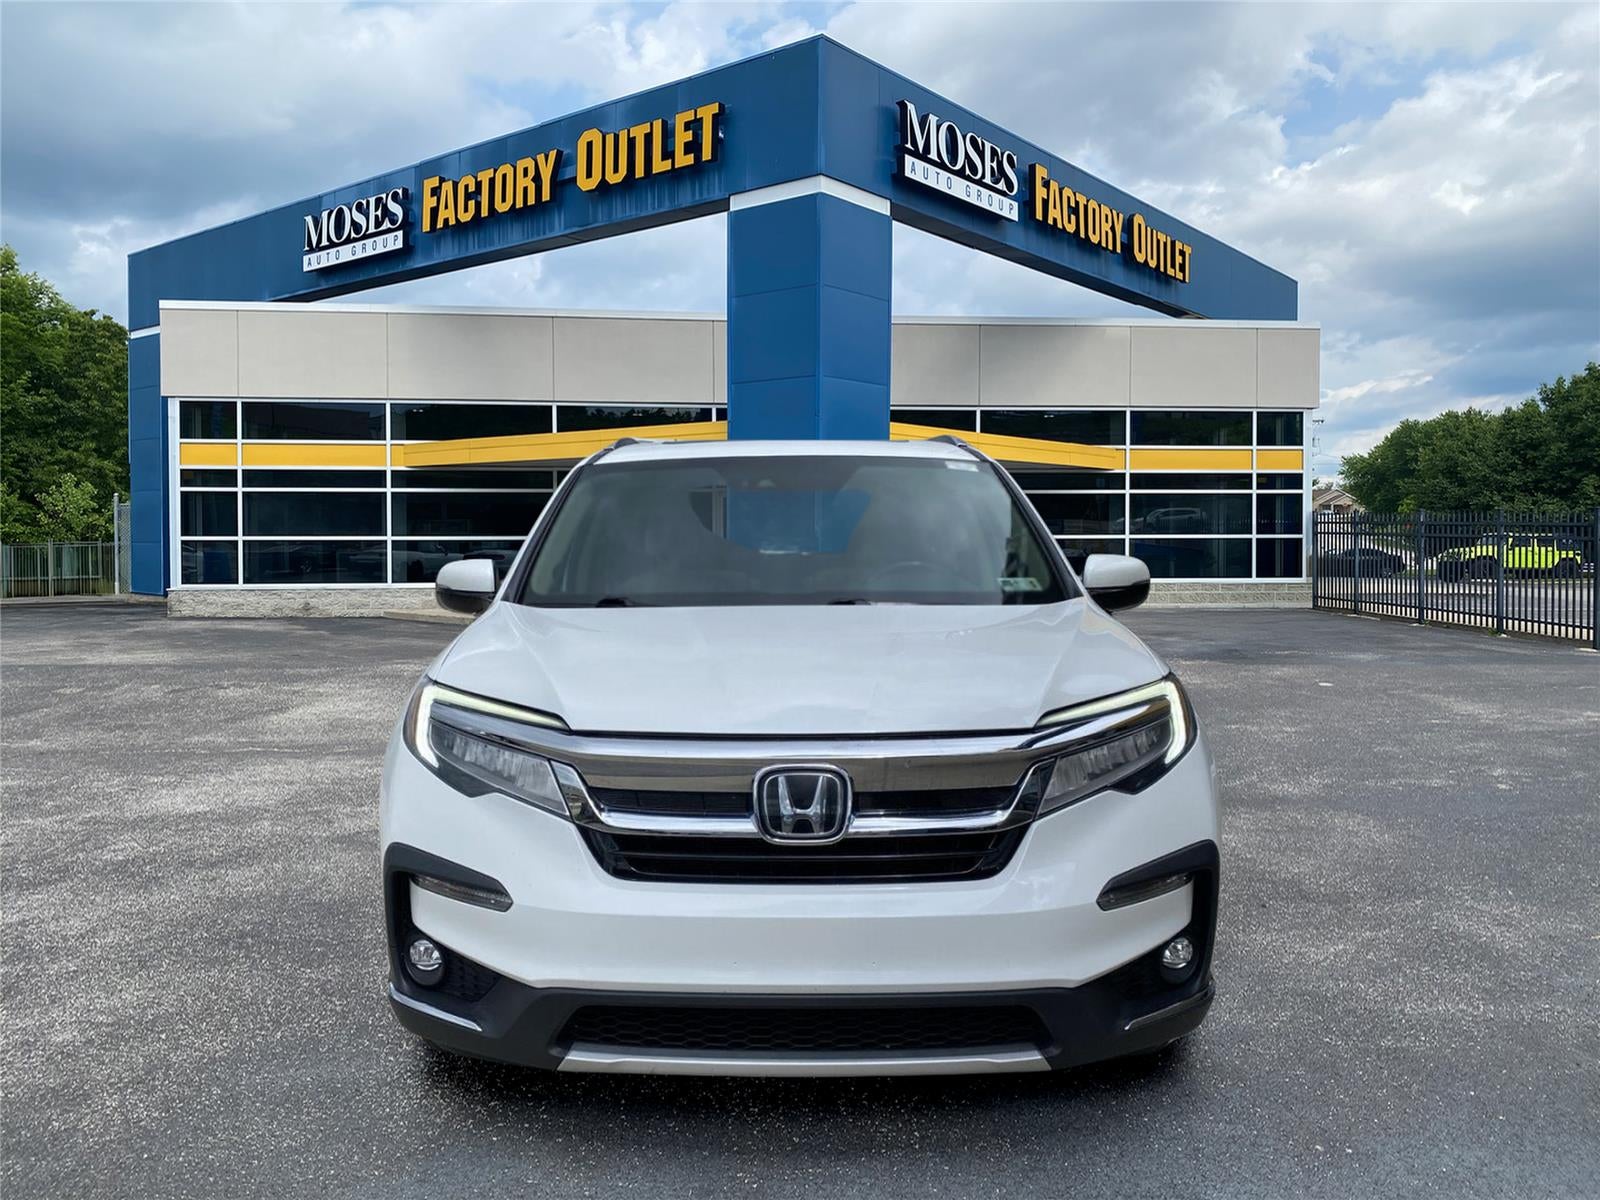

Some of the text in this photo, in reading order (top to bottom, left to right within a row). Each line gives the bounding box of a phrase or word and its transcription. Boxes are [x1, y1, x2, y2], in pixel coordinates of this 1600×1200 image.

[421, 101, 720, 233] FACTORY OUTLET
[904, 100, 1018, 196] MOSES
[910, 160, 1015, 214] AUTO GROUP
[303, 187, 403, 251] MOSES
[307, 234, 399, 267] AUTO GROUP
[1034, 162, 1192, 283] FACTORY OUTLET
